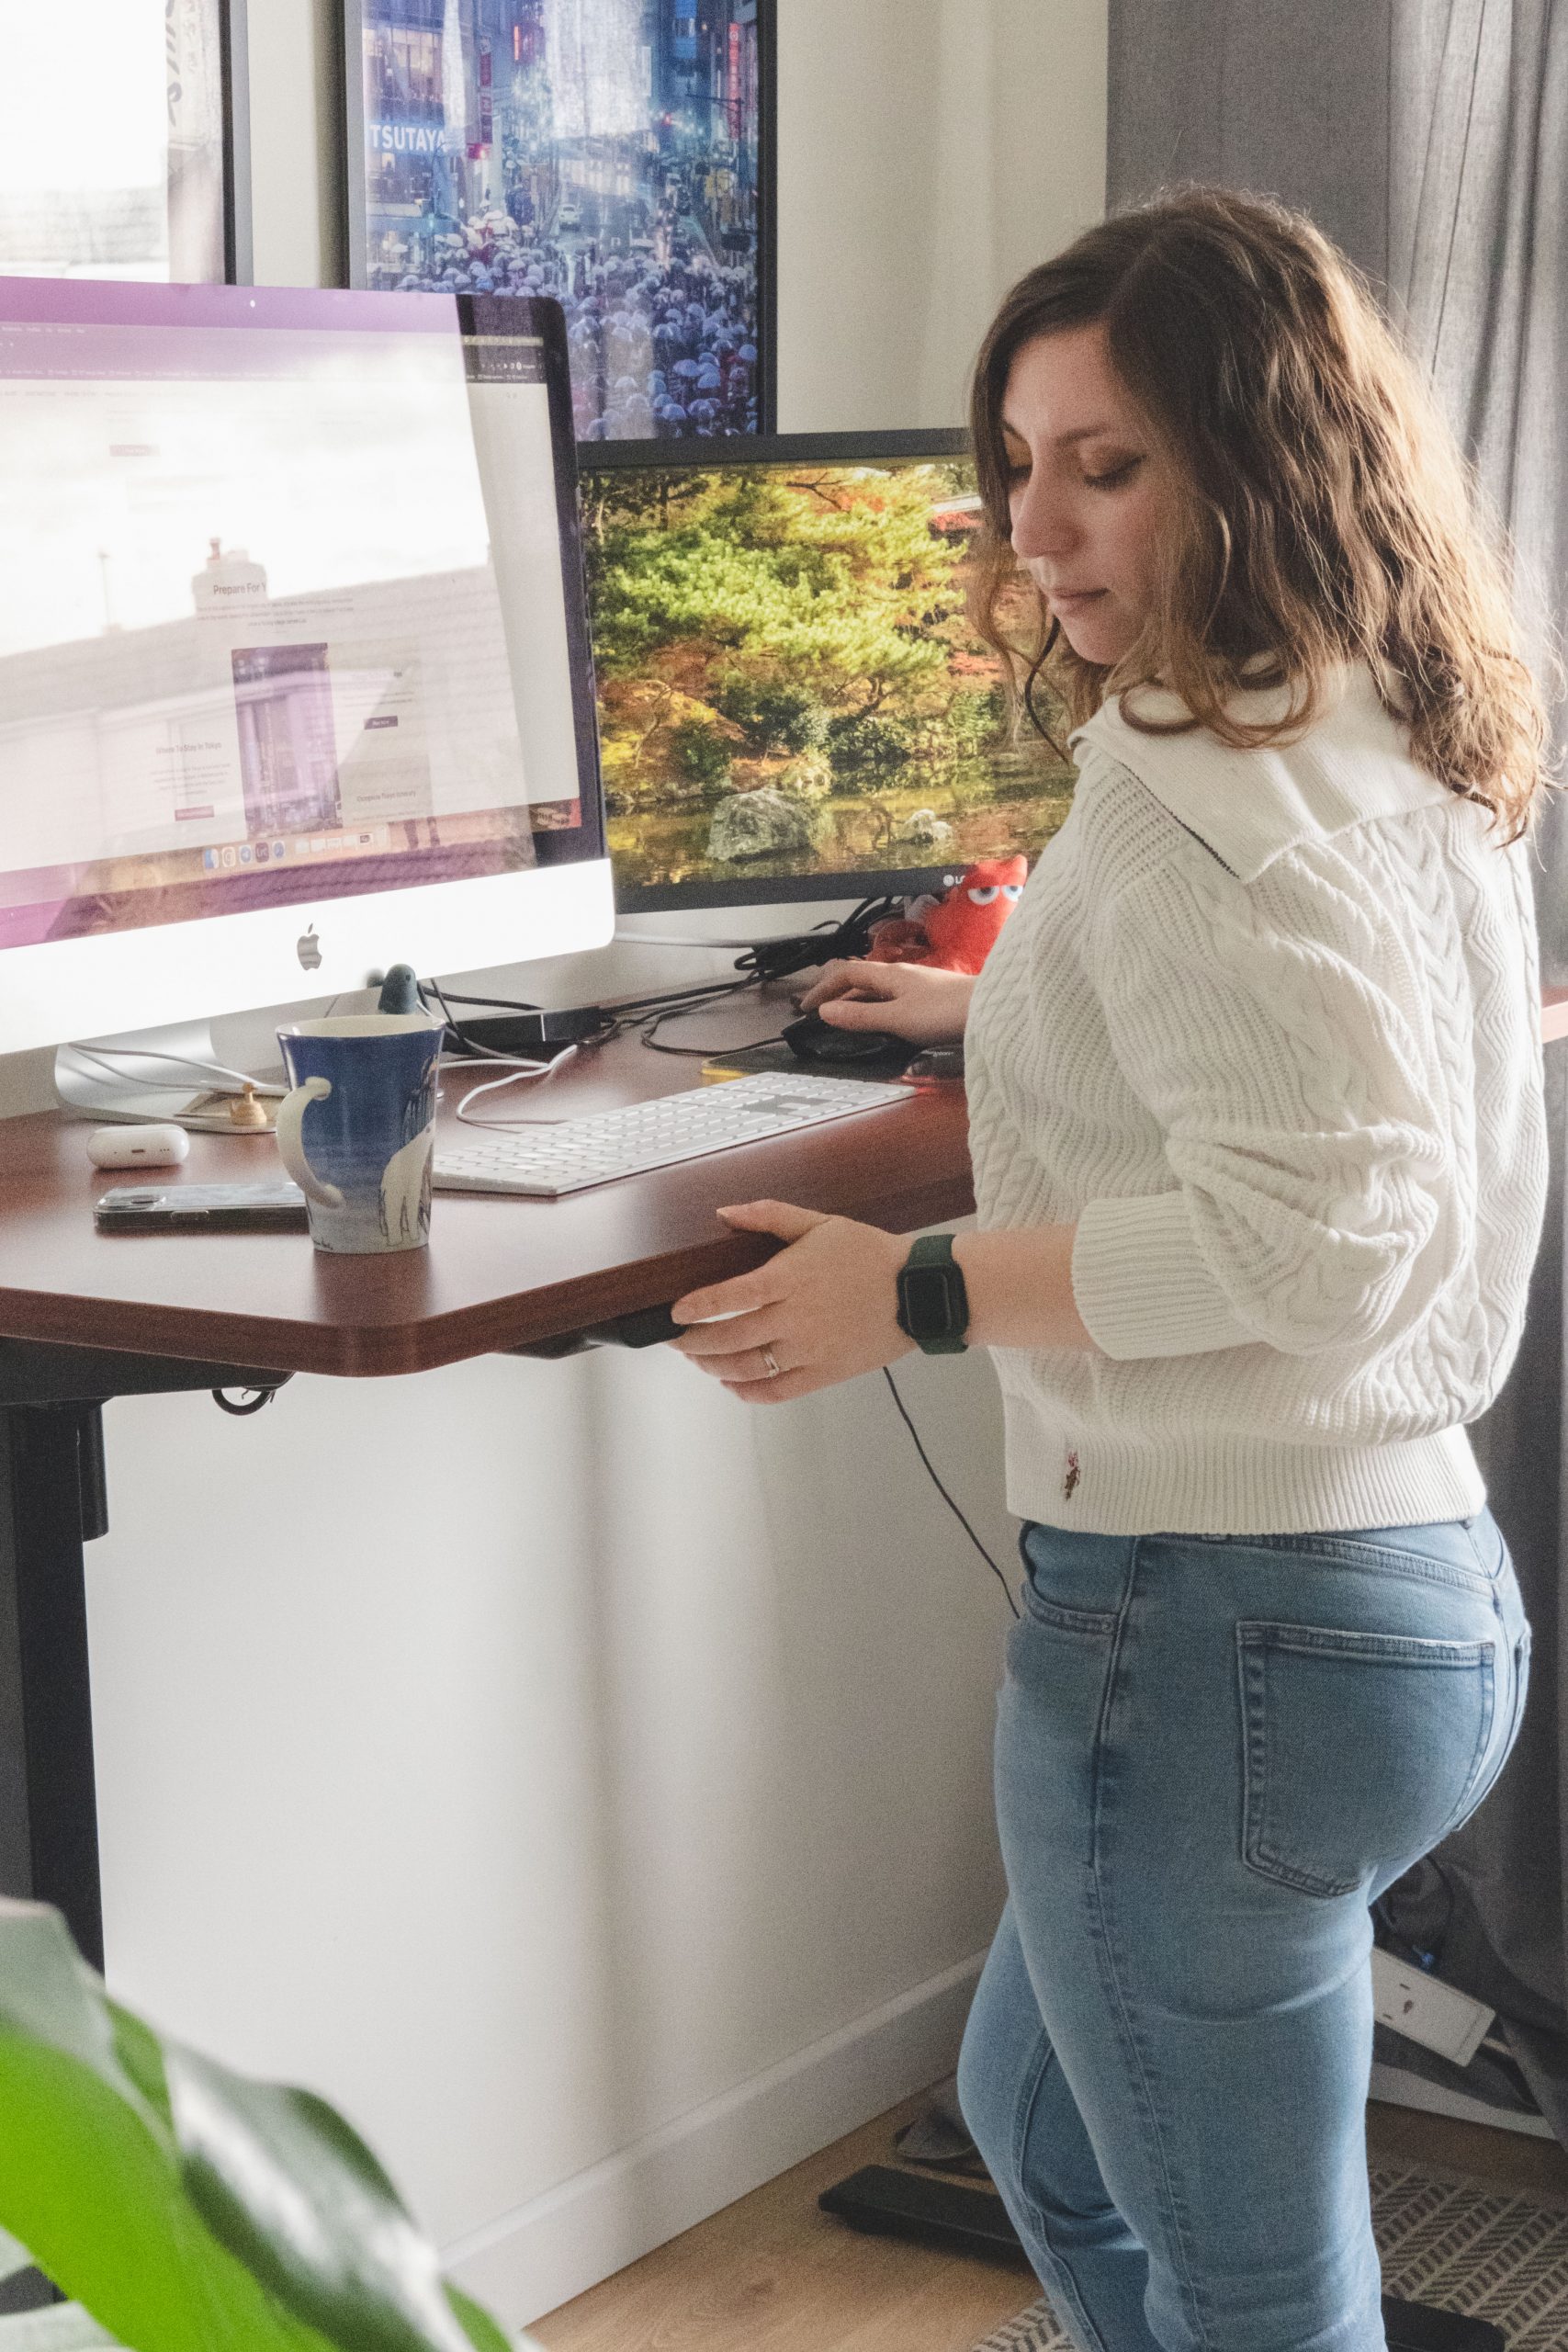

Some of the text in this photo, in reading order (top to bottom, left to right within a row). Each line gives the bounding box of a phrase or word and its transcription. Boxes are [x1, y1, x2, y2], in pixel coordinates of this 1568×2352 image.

[369, 123, 448, 153] TSUTAYA
[213, 583, 245, 596] Prepare
[246, 582, 260, 594] For
